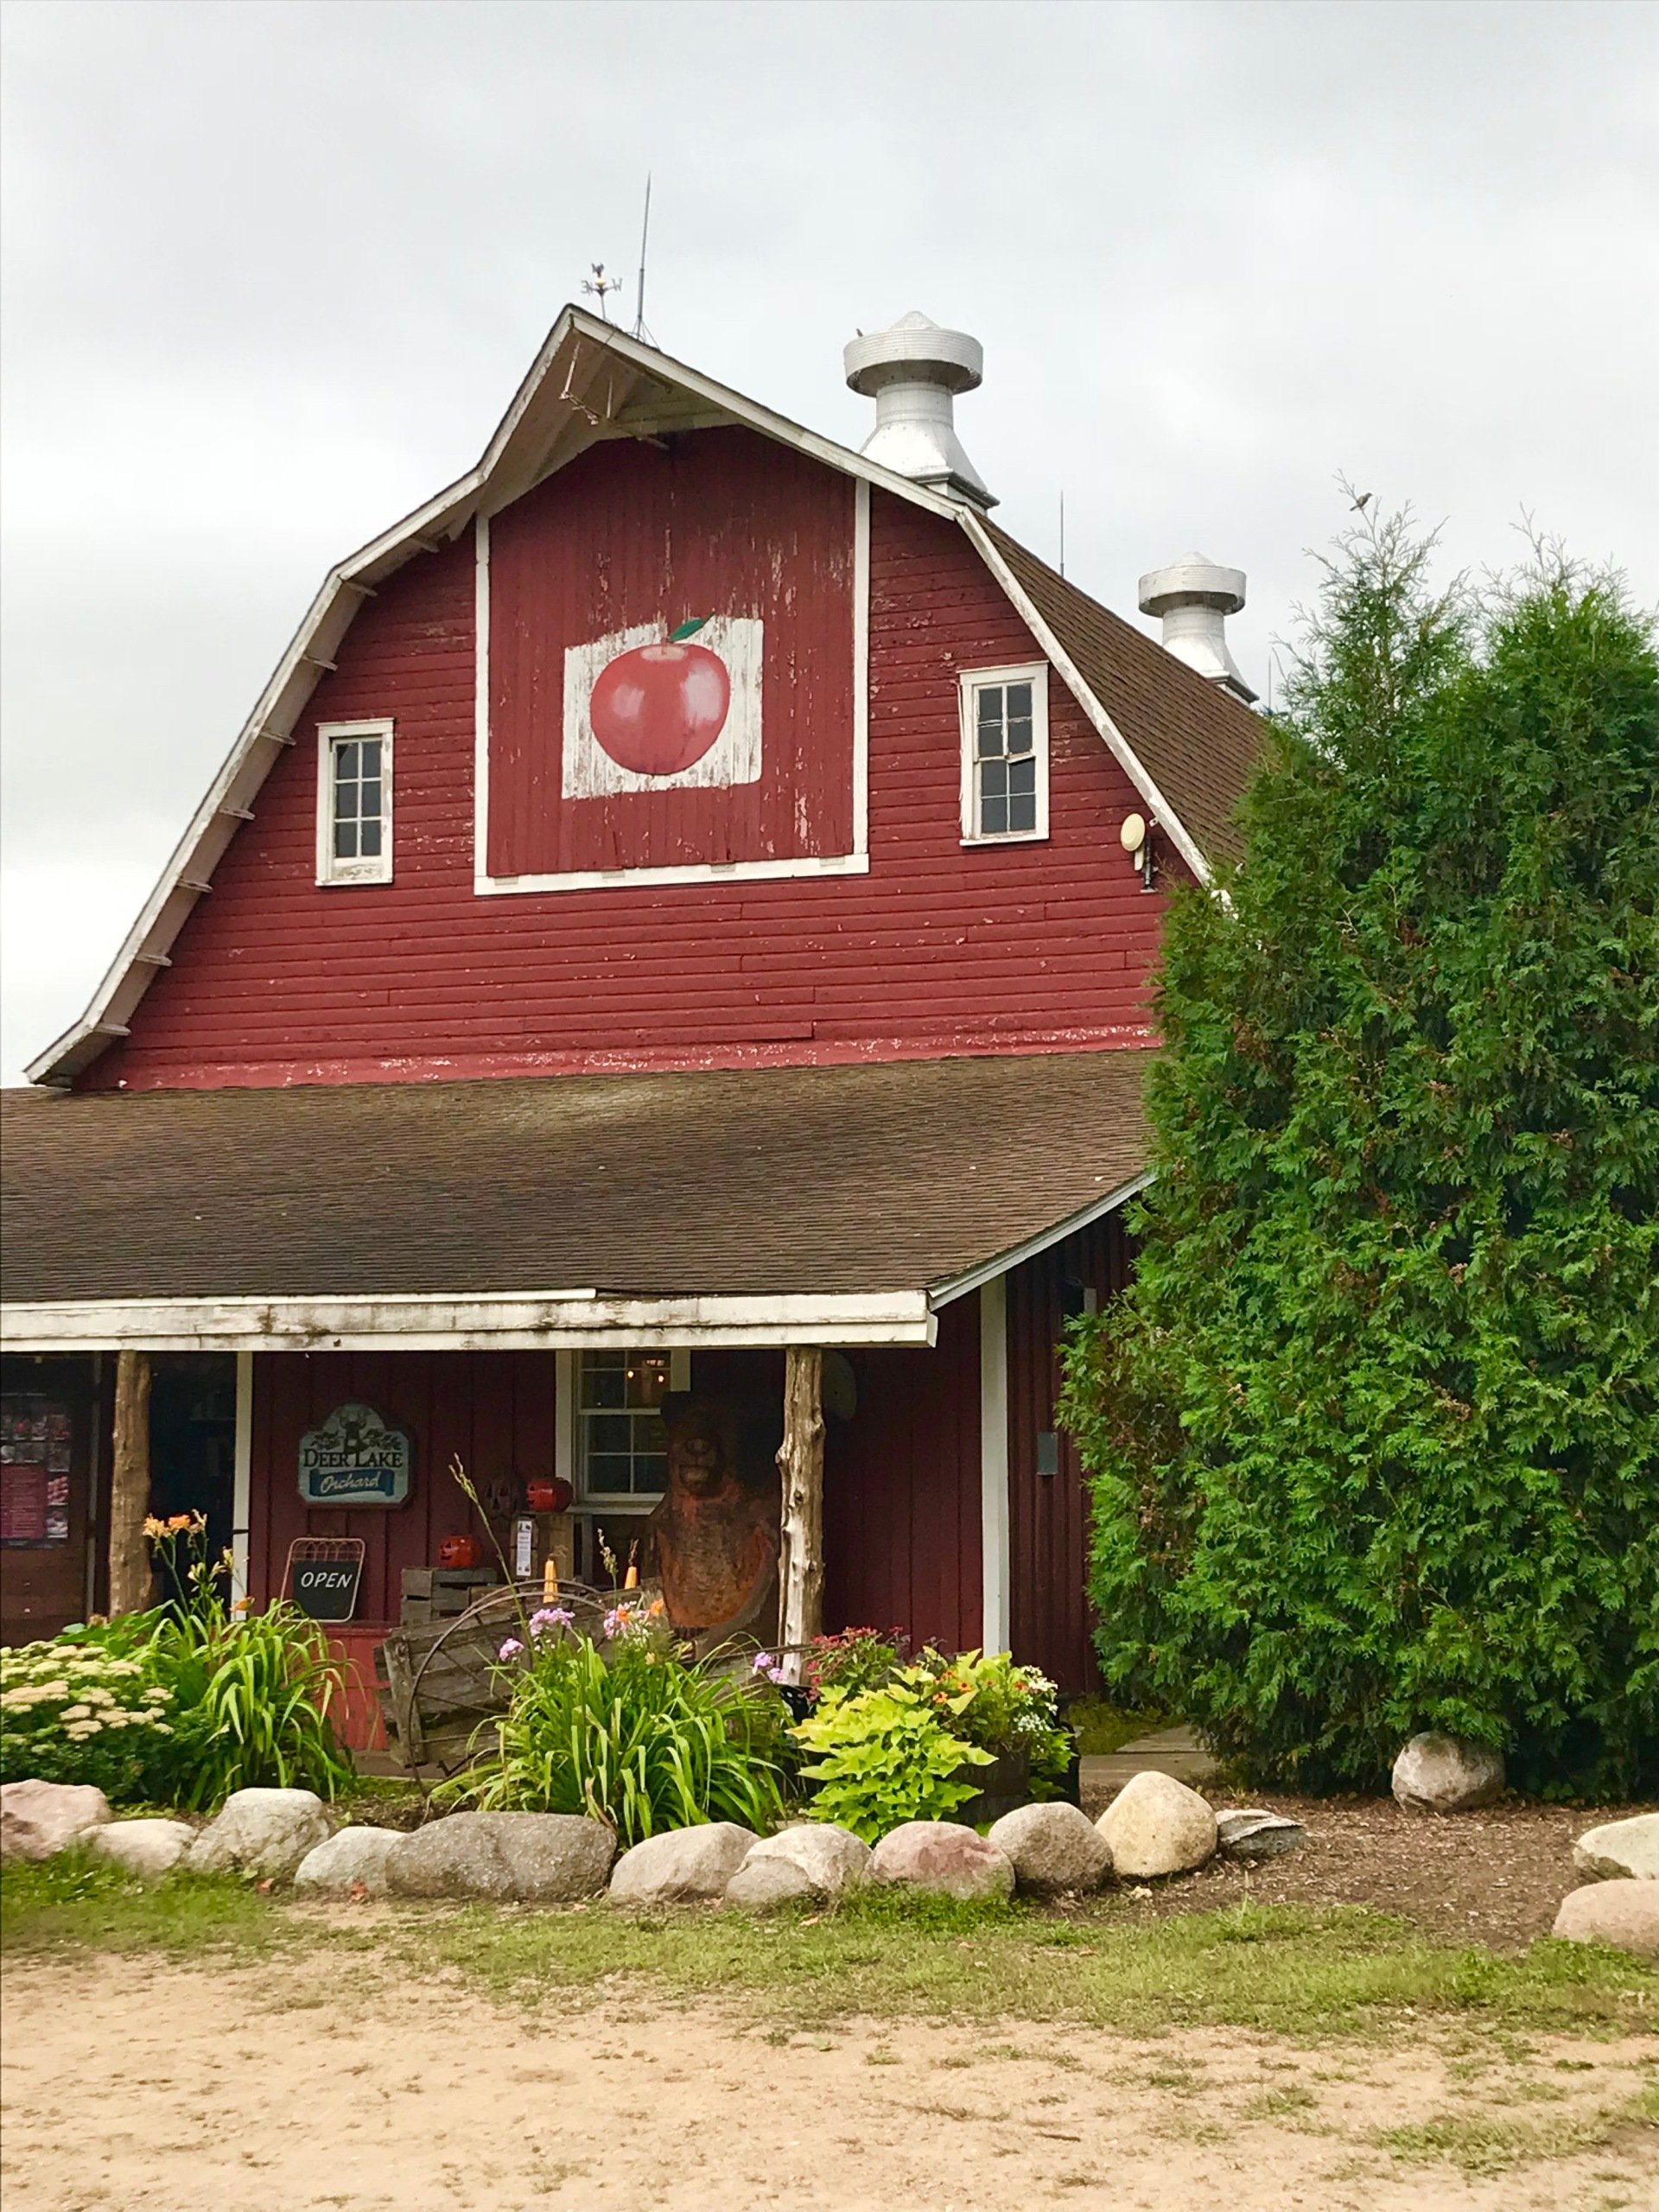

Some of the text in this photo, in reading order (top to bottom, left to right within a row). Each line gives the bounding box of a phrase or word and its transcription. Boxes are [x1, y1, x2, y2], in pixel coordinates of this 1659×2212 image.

[303, 1448, 404, 1468] DEER LAKE
[320, 1471, 381, 1493] Orchard
[301, 1572, 353, 1588] OPEN
